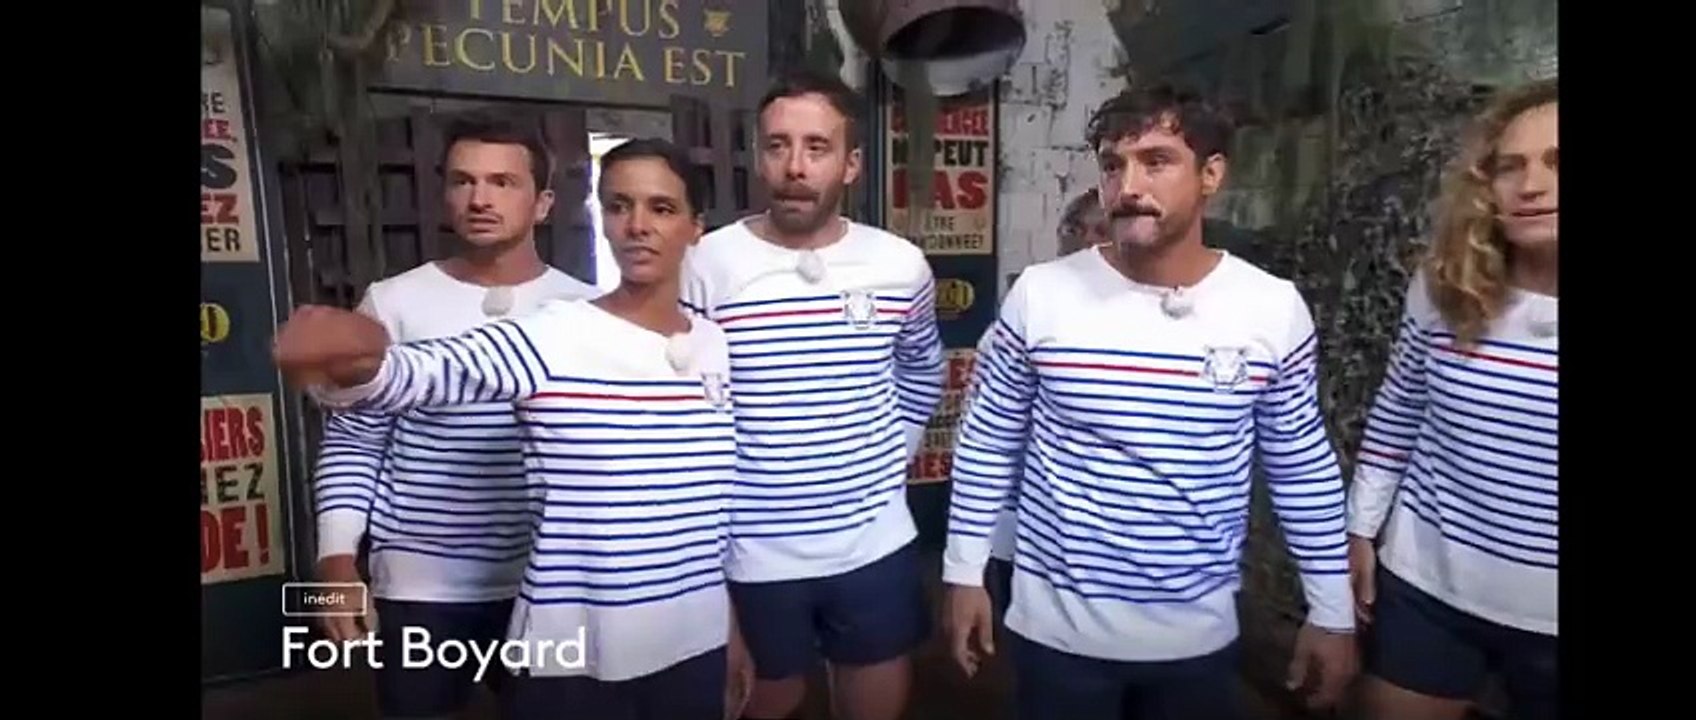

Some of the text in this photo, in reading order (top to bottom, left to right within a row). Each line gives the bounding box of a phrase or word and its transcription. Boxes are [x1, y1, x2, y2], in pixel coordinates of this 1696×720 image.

[385, 24, 746, 88] PECUNIA EST
[200, 406, 265, 461] IERS
